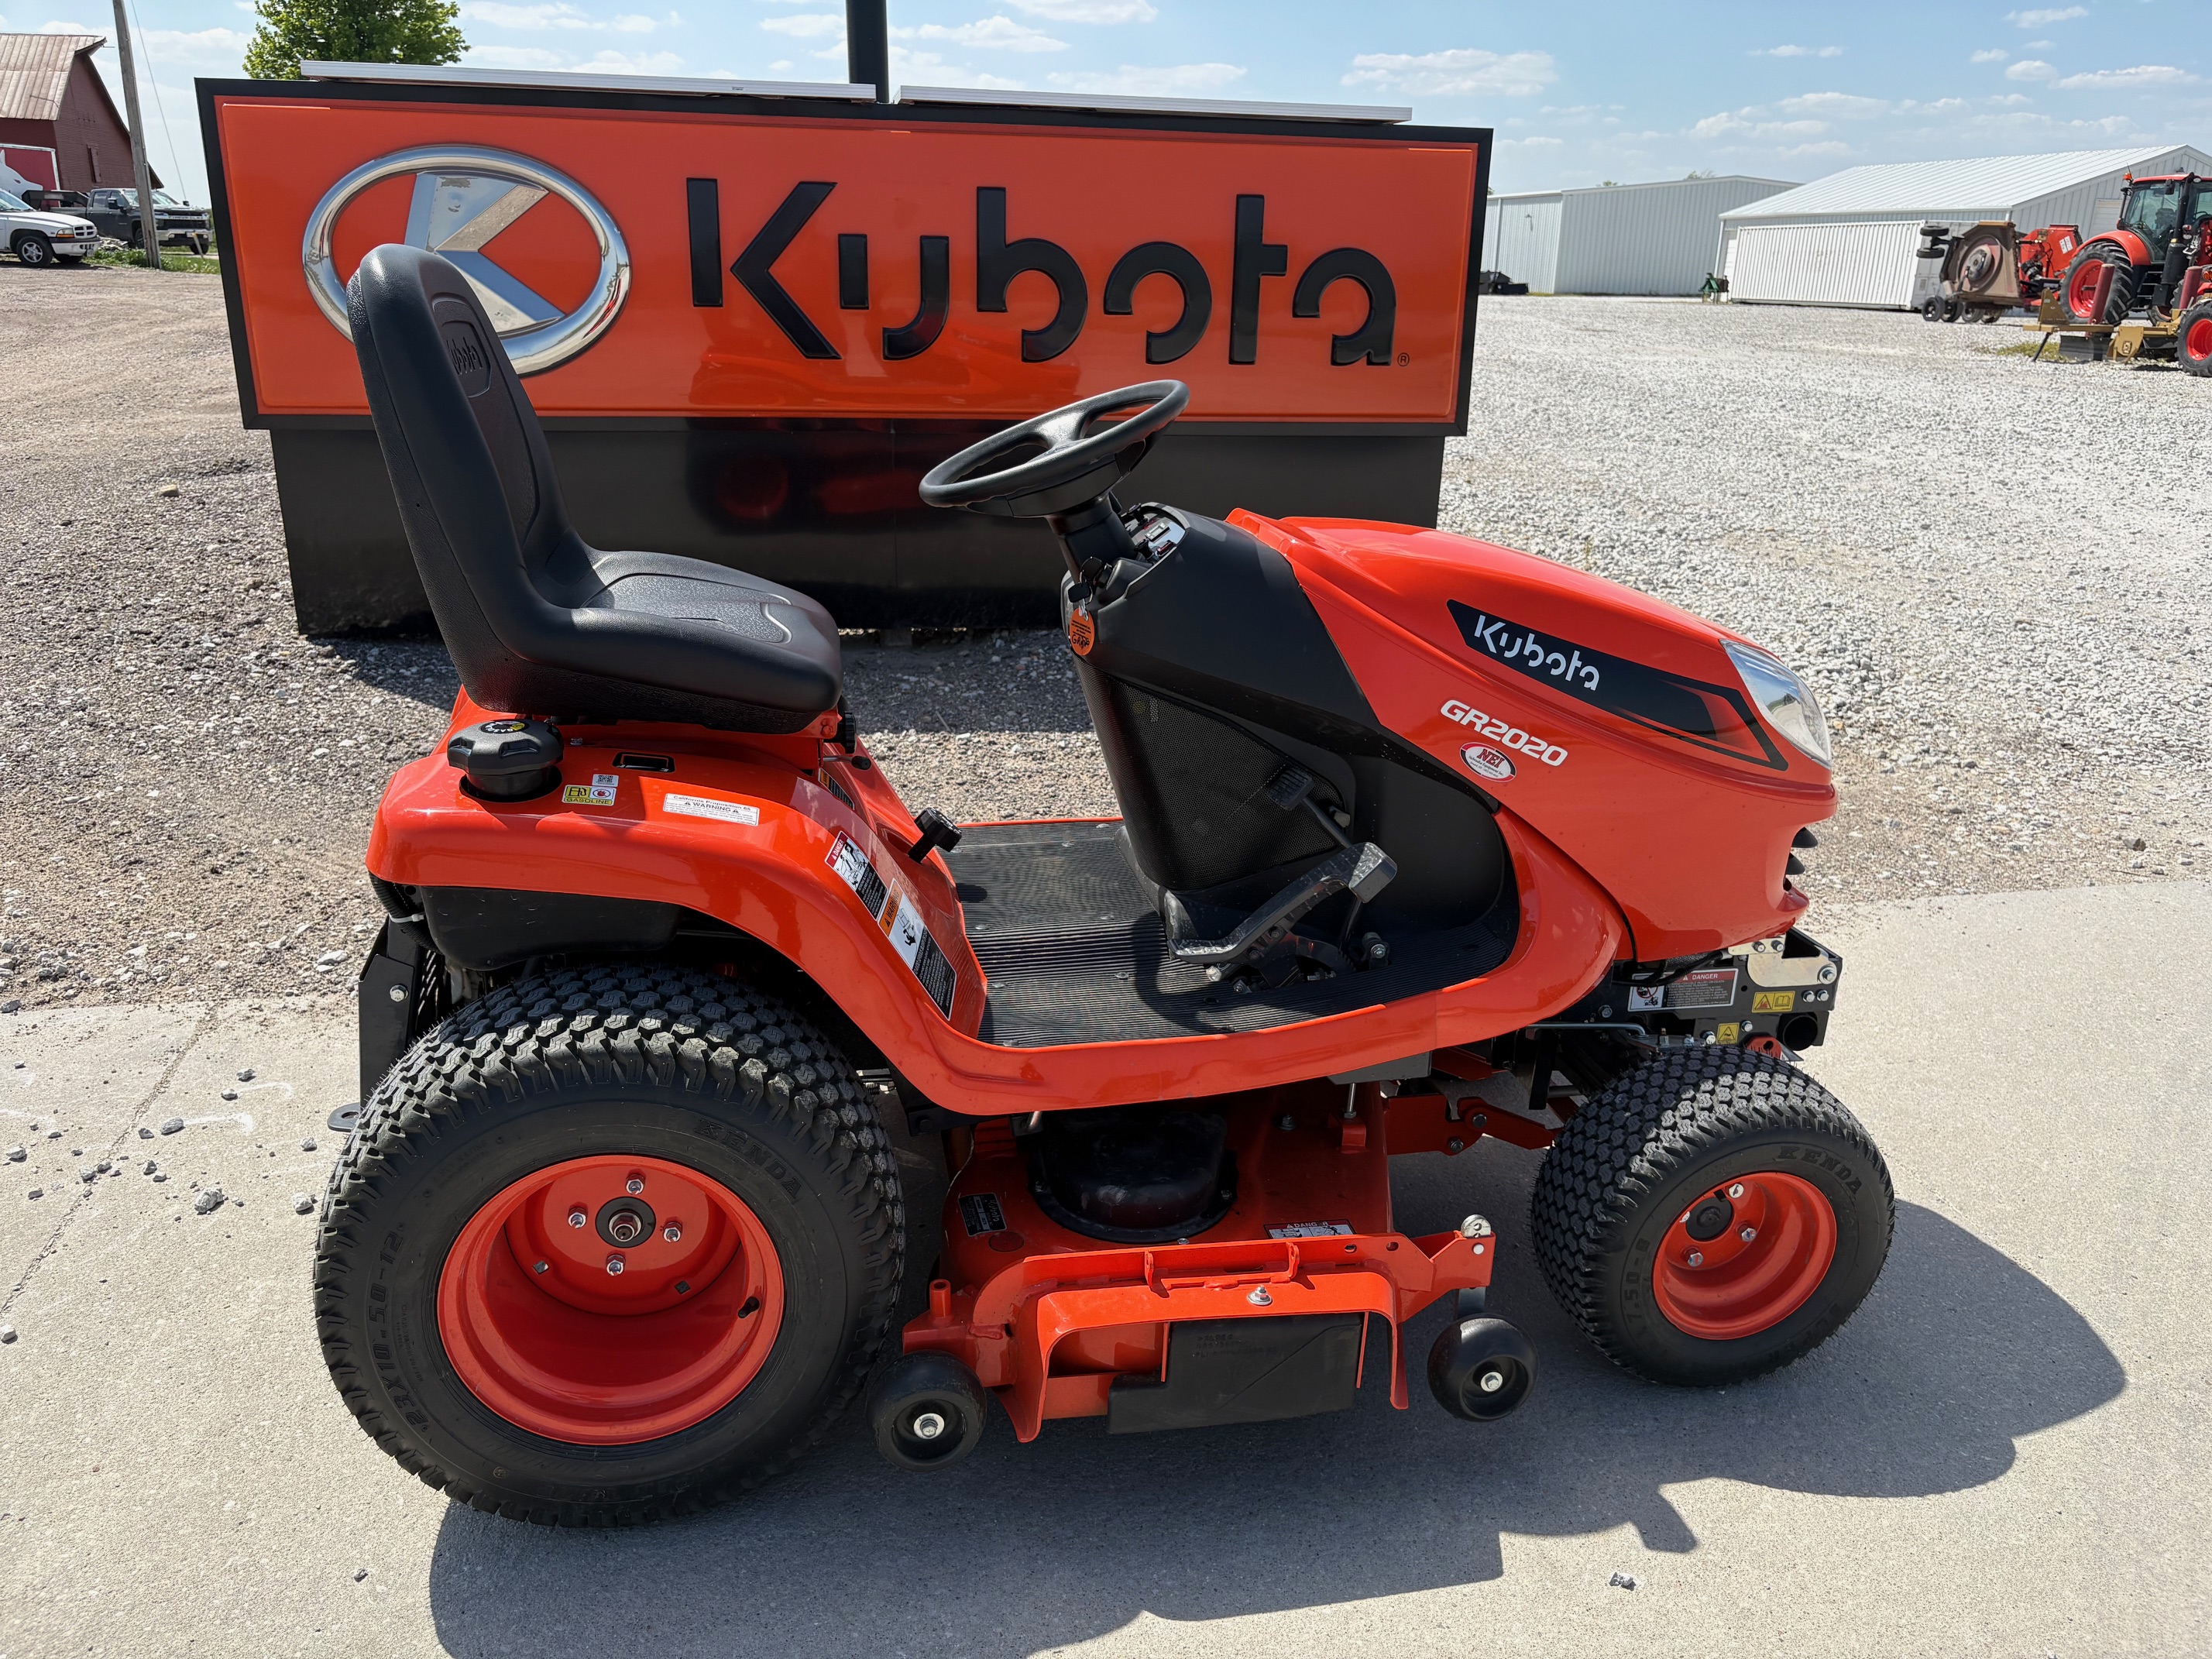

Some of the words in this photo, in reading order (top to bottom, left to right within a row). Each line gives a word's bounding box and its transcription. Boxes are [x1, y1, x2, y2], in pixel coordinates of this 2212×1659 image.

[685, 177, 1396, 366] Kubota
[1474, 614, 1601, 691] Kubota
[1439, 699, 1568, 767] GR2020
[1476, 748, 1505, 768] NEI
[692, 802, 731, 812] WARNING
[706, 800, 742, 809] Proposition
[834, 839, 844, 857] DANGER
[886, 890, 899, 919] WARNING
[695, 1118, 804, 1200] KENDA
[1777, 1146, 1863, 1192] KENDA
[368, 1230, 428, 1426] 23X10.50-12
